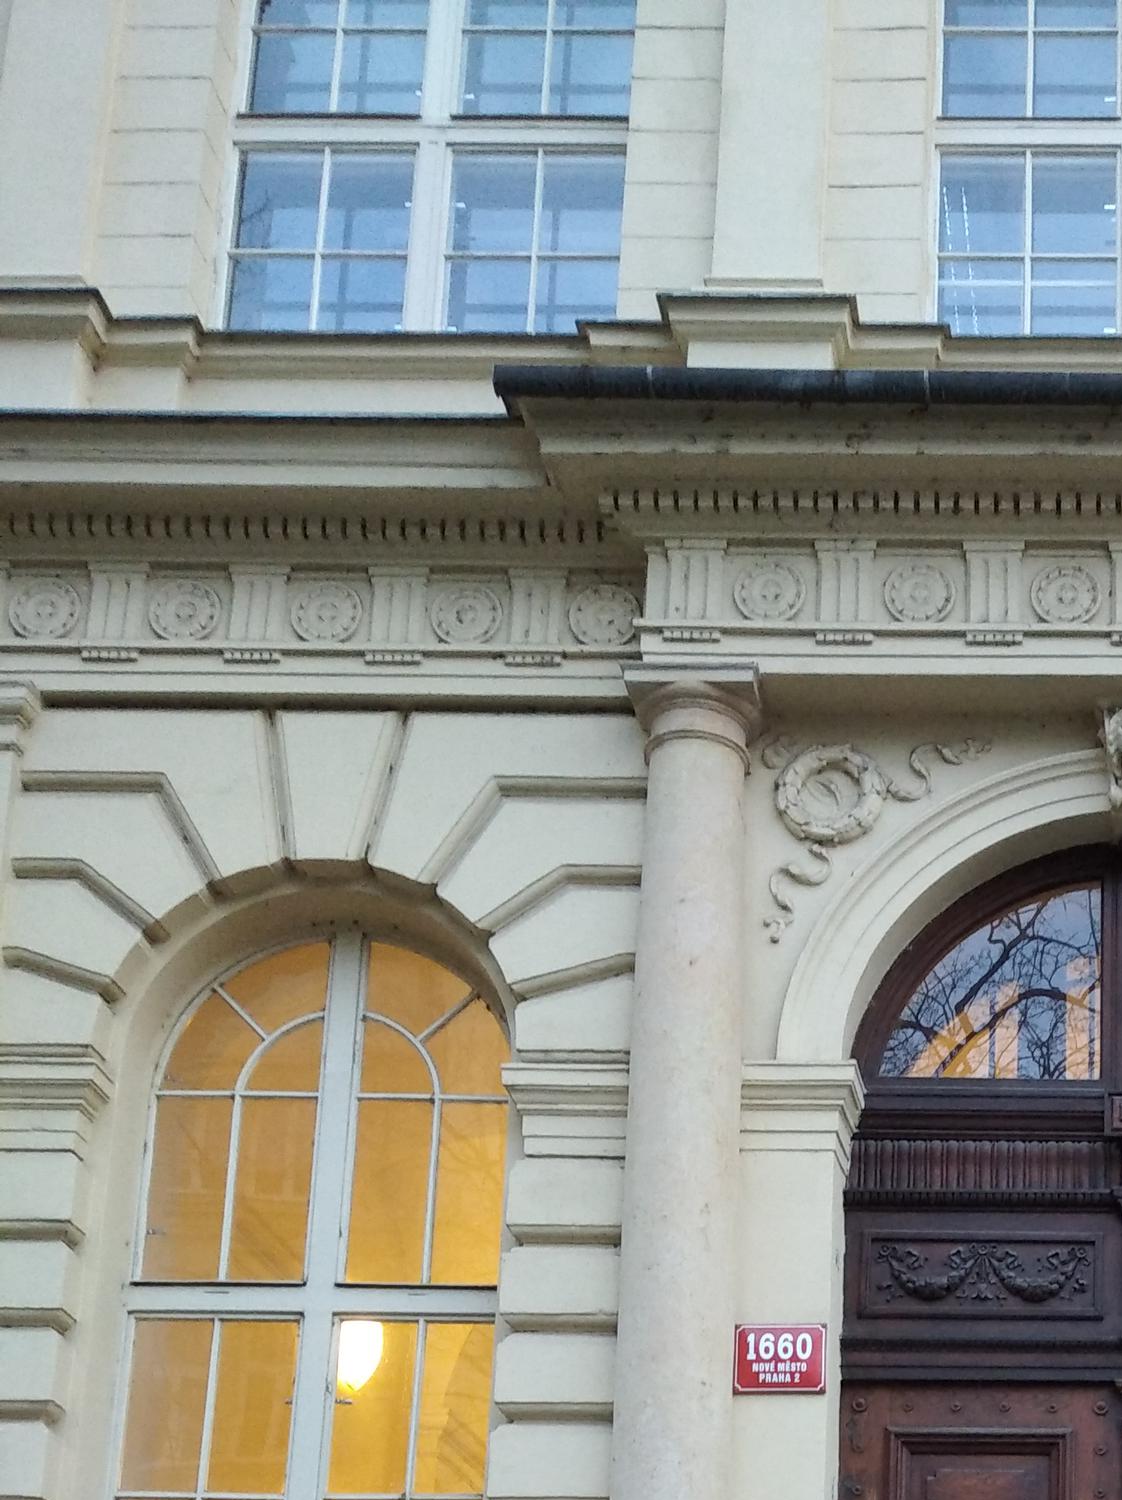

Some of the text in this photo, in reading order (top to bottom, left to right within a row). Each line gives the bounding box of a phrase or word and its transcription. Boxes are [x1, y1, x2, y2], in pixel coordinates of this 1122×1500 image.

[746, 1332, 813, 1360] 1660
[752, 1360, 807, 1372] NOVÉ MĚSTO
[758, 1373, 800, 1383] PRAHA 2
